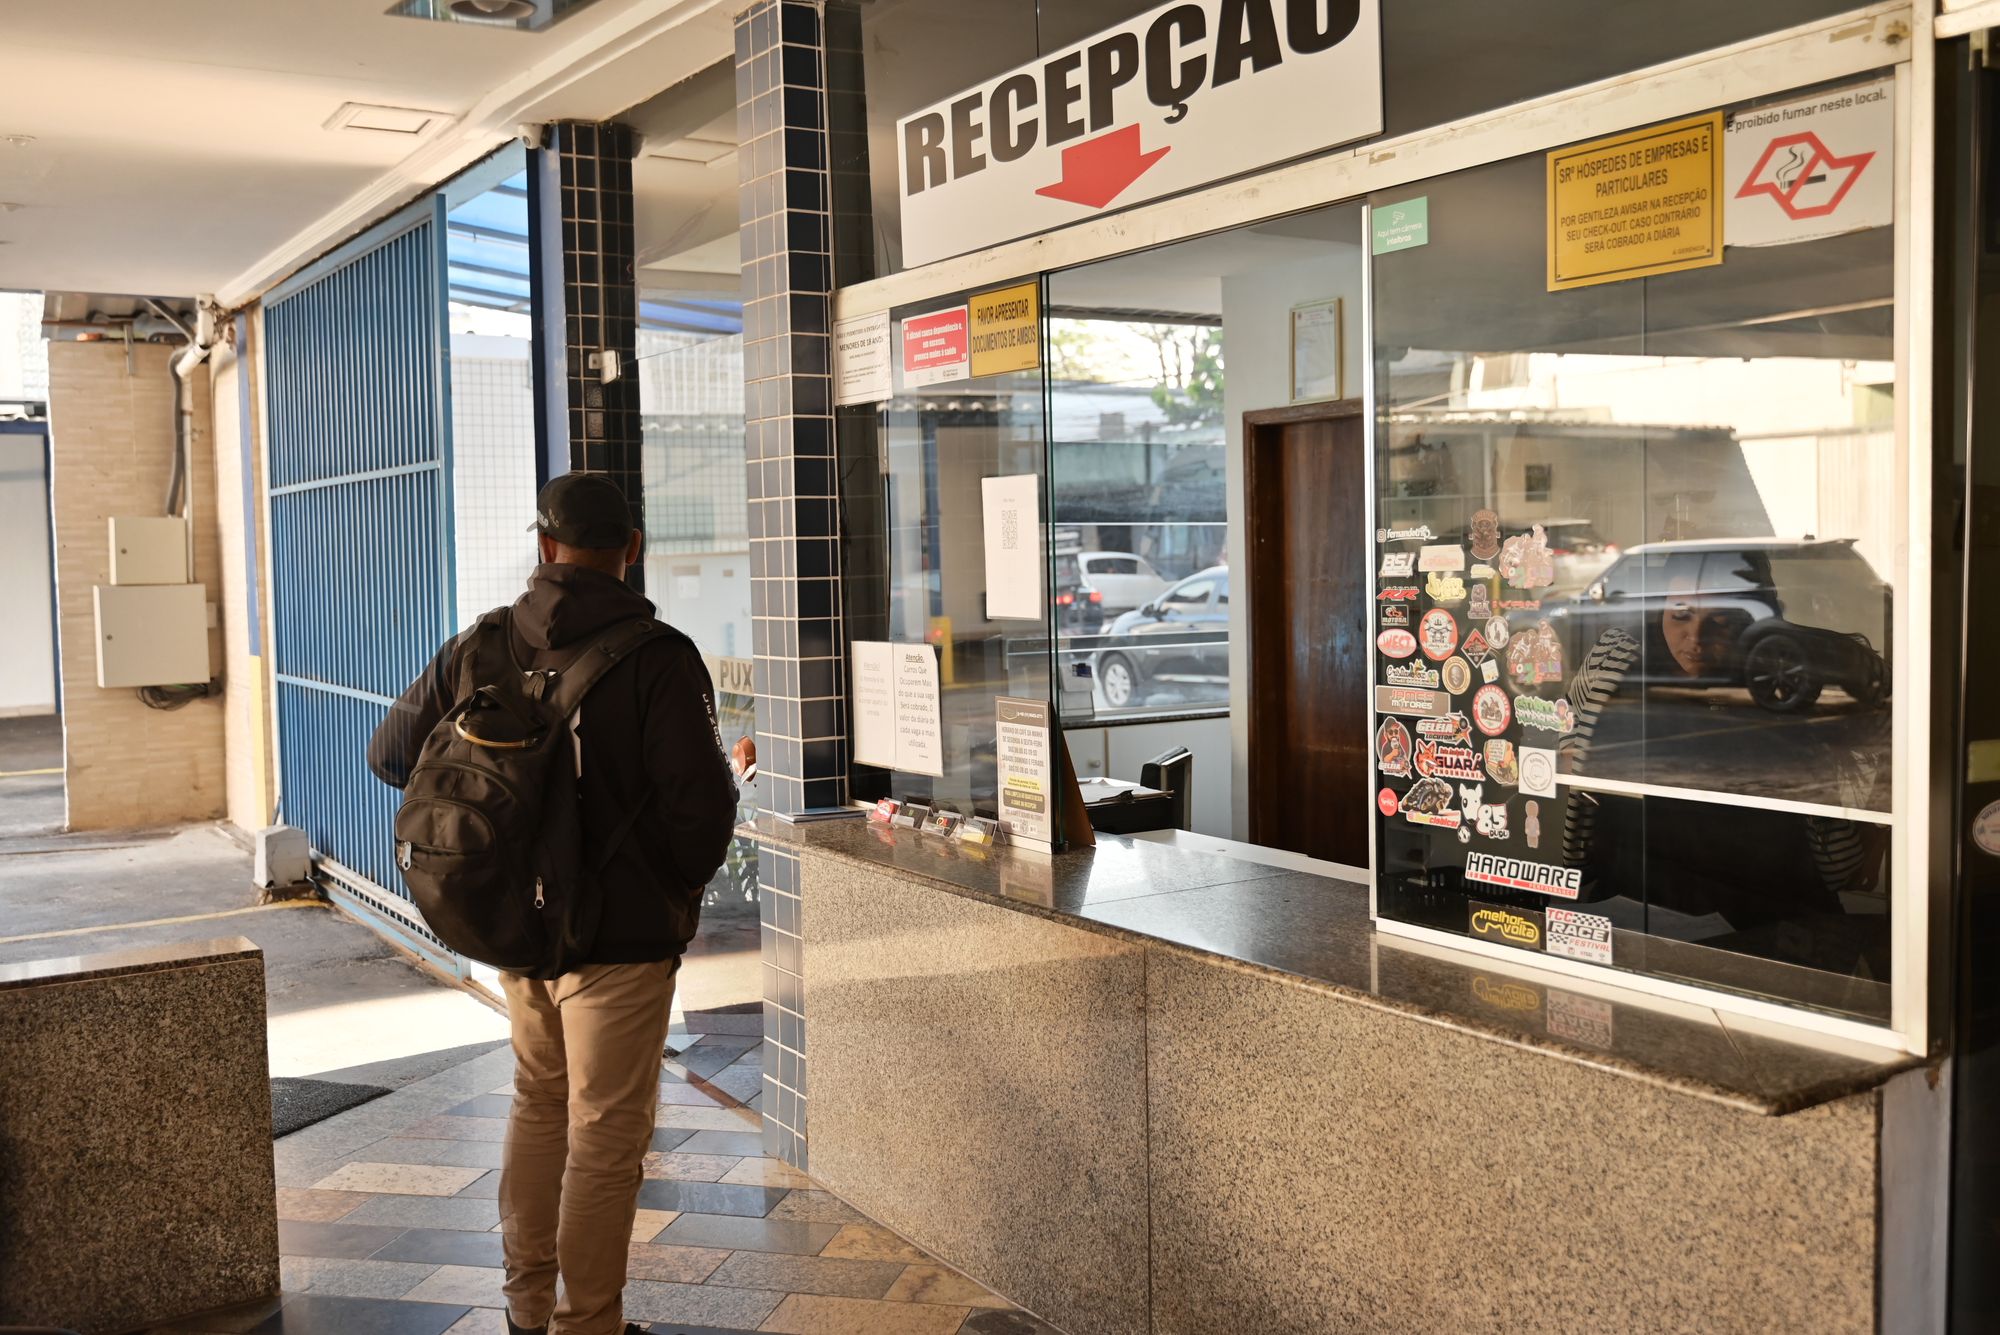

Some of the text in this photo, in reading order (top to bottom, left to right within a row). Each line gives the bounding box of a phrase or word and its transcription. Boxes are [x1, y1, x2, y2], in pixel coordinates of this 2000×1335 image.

[1735, 112, 1780, 133] proibido
[1782, 105, 1818, 121] fumar
[1820, 98, 1852, 113] neste
[1855, 88, 1887, 105] local.
[1576, 154, 1627, 180] HÓSPEDES
[1629, 150, 1642, 168] DE
[1645, 138, 1699, 165] EMPRESAS
[1702, 135, 1709, 151] E
[1596, 168, 1668, 198] PARTICULARES
[1561, 188, 1707, 228] POR GENTILEZA AVISAR NA RECEPÇÃO
[1566, 230, 1581, 242] SEU
[1629, 216, 1651, 230] CASO
[1653, 206, 1700, 225] CONTRÁRIO
[1606, 232, 1645, 250] COBRADO
[1646, 232, 1652, 242] A
[977, 298, 1029, 326] FAVOR APRESENTAR
[840, 341, 859, 351] MENORES
[860, 339, 866, 348] DE
[972, 324, 1036, 354] DOCUMENTOS DE AMBOS
[720, 659, 753, 692] PUX
[1436, 753, 1482, 771] GUARÁ
[1476, 804, 1507, 835] 85
[1468, 854, 1579, 890] HARDWARE
[1480, 909, 1524, 926] melhor
[1504, 923, 1535, 938] volta
[1547, 909, 1574, 923] TCC
[1552, 922, 1608, 941] RACE
[1569, 939, 1610, 953] FESTIVAL
